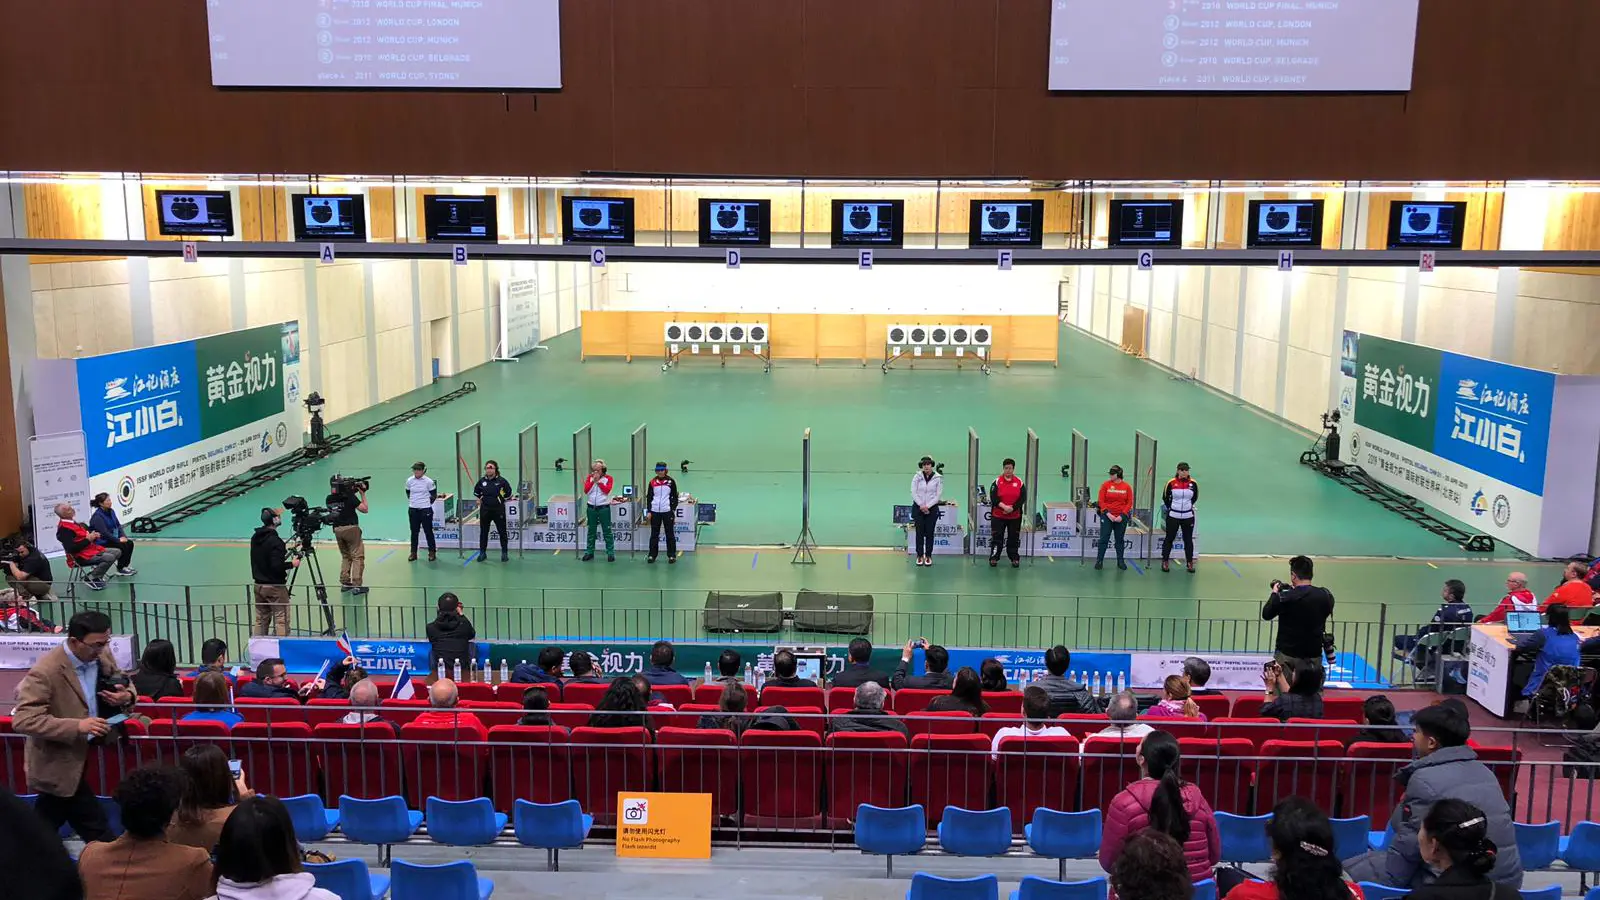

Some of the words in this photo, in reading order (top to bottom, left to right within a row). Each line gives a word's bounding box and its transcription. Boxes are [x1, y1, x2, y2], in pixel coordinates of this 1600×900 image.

[1225, 20, 1255, 28] WORLD
[1223, 57, 1252, 65] WORLD
[378, 72, 407, 80] WORLD
[1222, 75, 1250, 83] WORLD
[322, 245, 333, 260] A
[455, 247, 466, 262] B
[593, 249, 604, 264] C
[728, 251, 739, 266] D
[861, 251, 871, 267] E
[1000, 252, 1010, 267] F
[1140, 252, 1151, 267] G
[1280, 252, 1291, 268] H
[206, 352, 277, 408] 黄金视力
[1363, 362, 1430, 419] 黄金视力
[105, 398, 178, 449] 江小白
[1450, 405, 1522, 459] 江小白
[136, 476, 148, 485] ISSF
[148, 468, 165, 480] WORLD
[166, 464, 176, 474] CUP
[176, 459, 189, 470] RIFLE
[149, 483, 163, 498] 2019
[508, 505, 517, 515] B
[556, 507, 568, 516] R1
[618, 507, 627, 517] D
[676, 508, 684, 517] E
[937, 510, 945, 520] F
[1055, 513, 1068, 522] R2
[533, 531, 576, 543] 黄金视力
[623, 828, 666, 836] 请勿使用闪光灯
[645, 837, 681, 845] Photography
